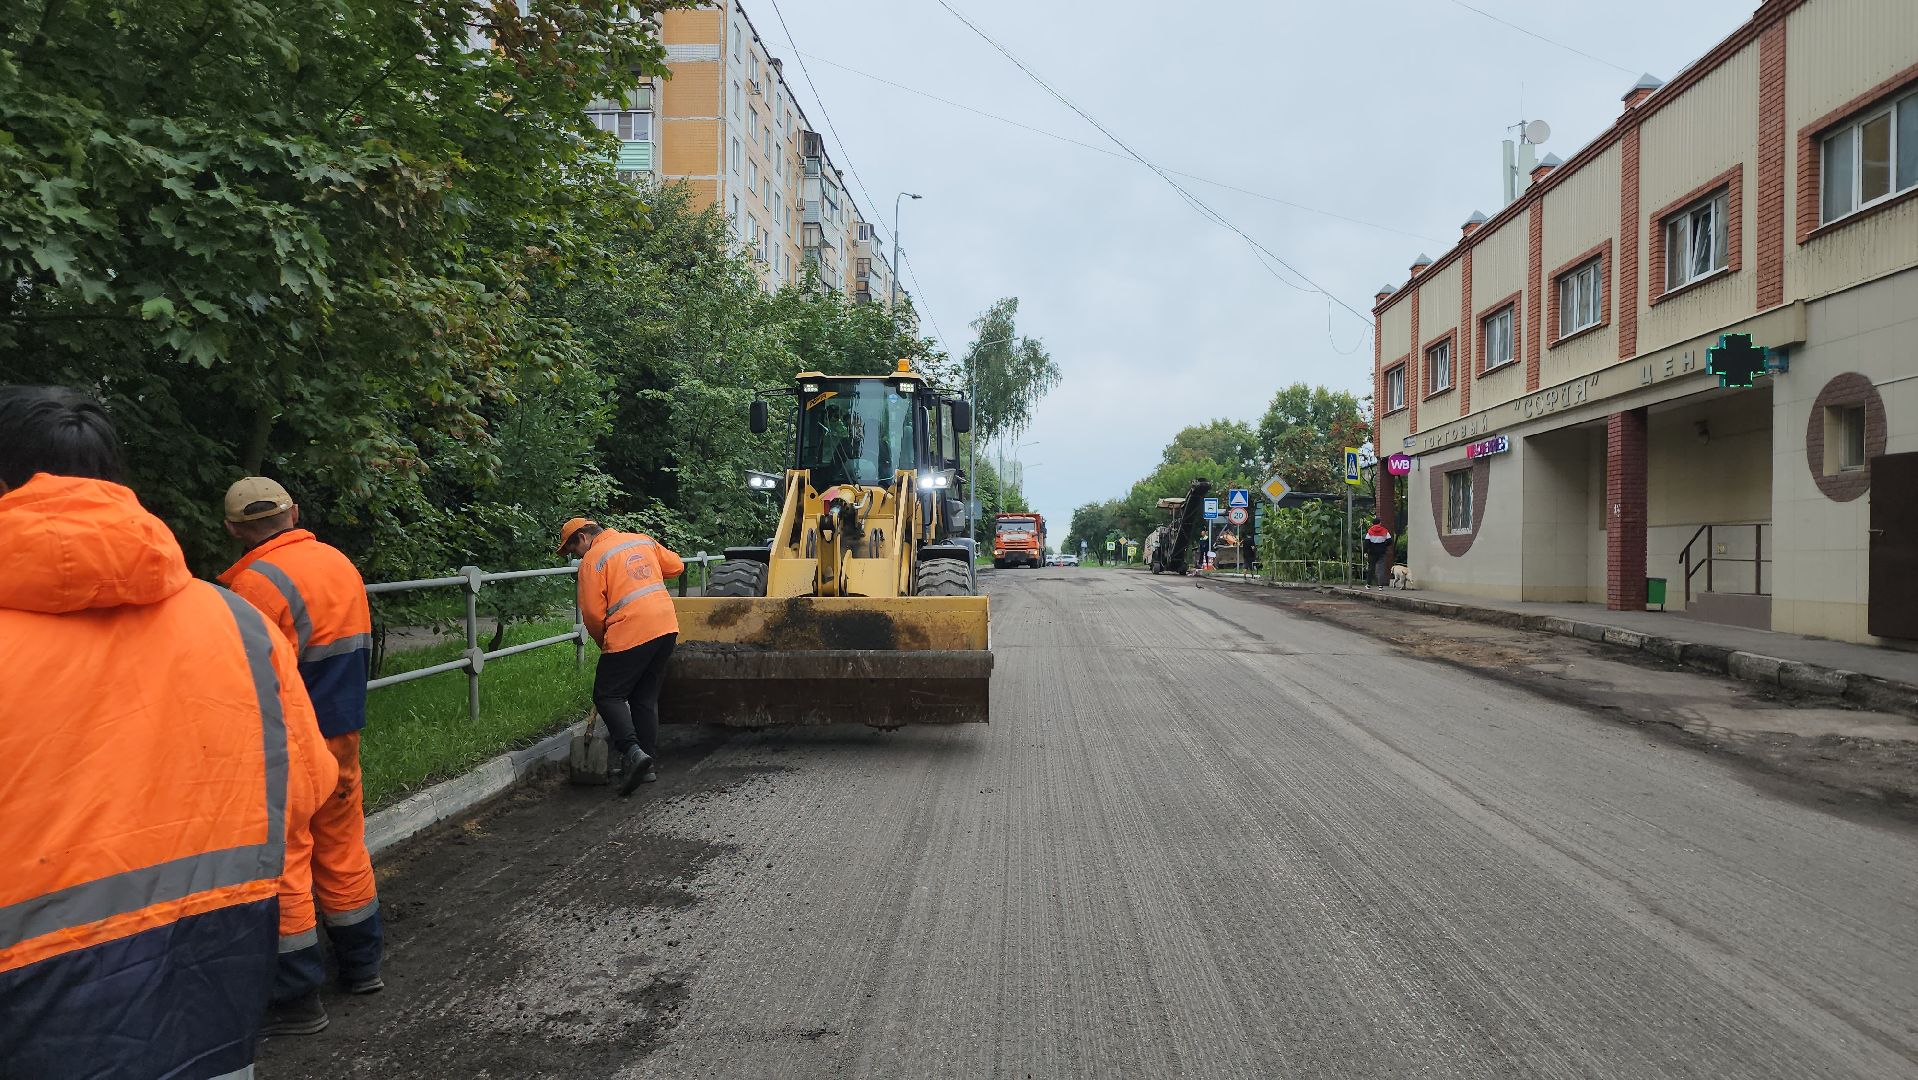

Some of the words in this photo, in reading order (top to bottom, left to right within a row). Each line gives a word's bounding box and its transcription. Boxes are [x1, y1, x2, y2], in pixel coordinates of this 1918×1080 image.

[1423, 414, 1489, 450] ТОРГОВЫЙ
[1639, 349, 1696, 386] ЦЕН
[1390, 459, 1410, 470] WB
[1233, 512, 1244, 520] 20
